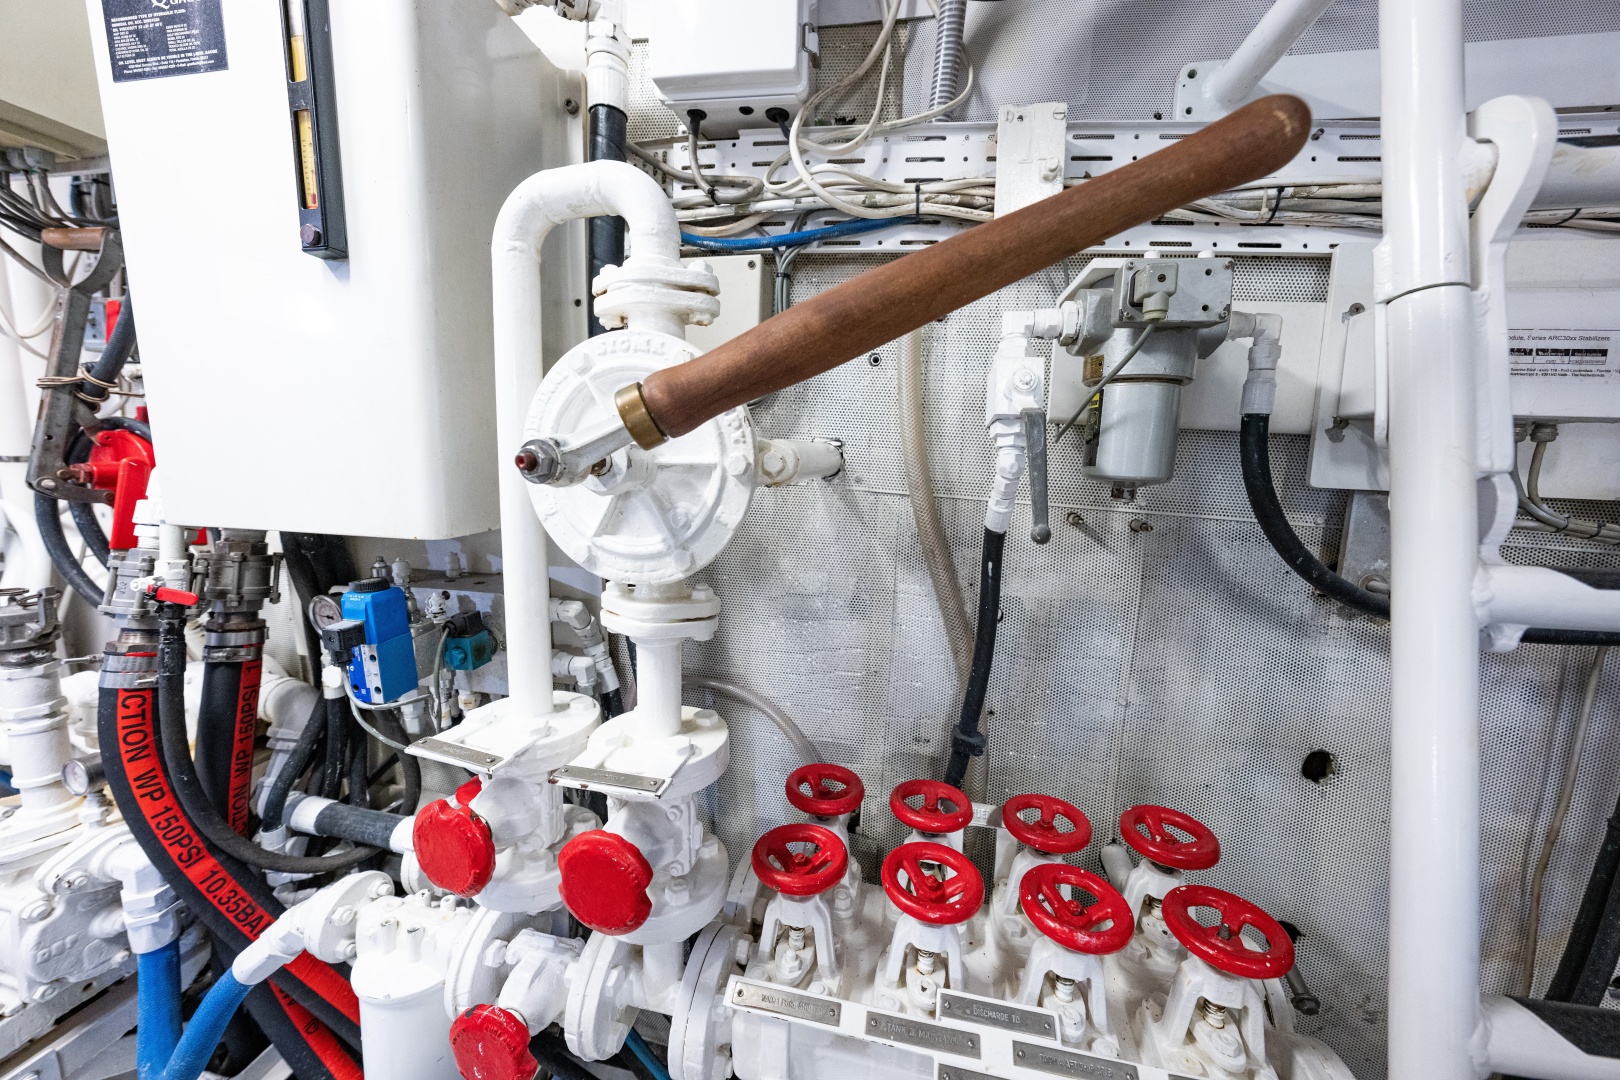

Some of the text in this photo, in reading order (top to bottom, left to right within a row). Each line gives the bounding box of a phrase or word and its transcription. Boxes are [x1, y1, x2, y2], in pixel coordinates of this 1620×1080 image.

[239, 684, 258, 744] 150PSI
[234, 749, 250, 779] WP
[133, 767, 165, 802] WP
[150, 805, 205, 869] 150PSI
[886, 1022, 907, 1033] TANK
